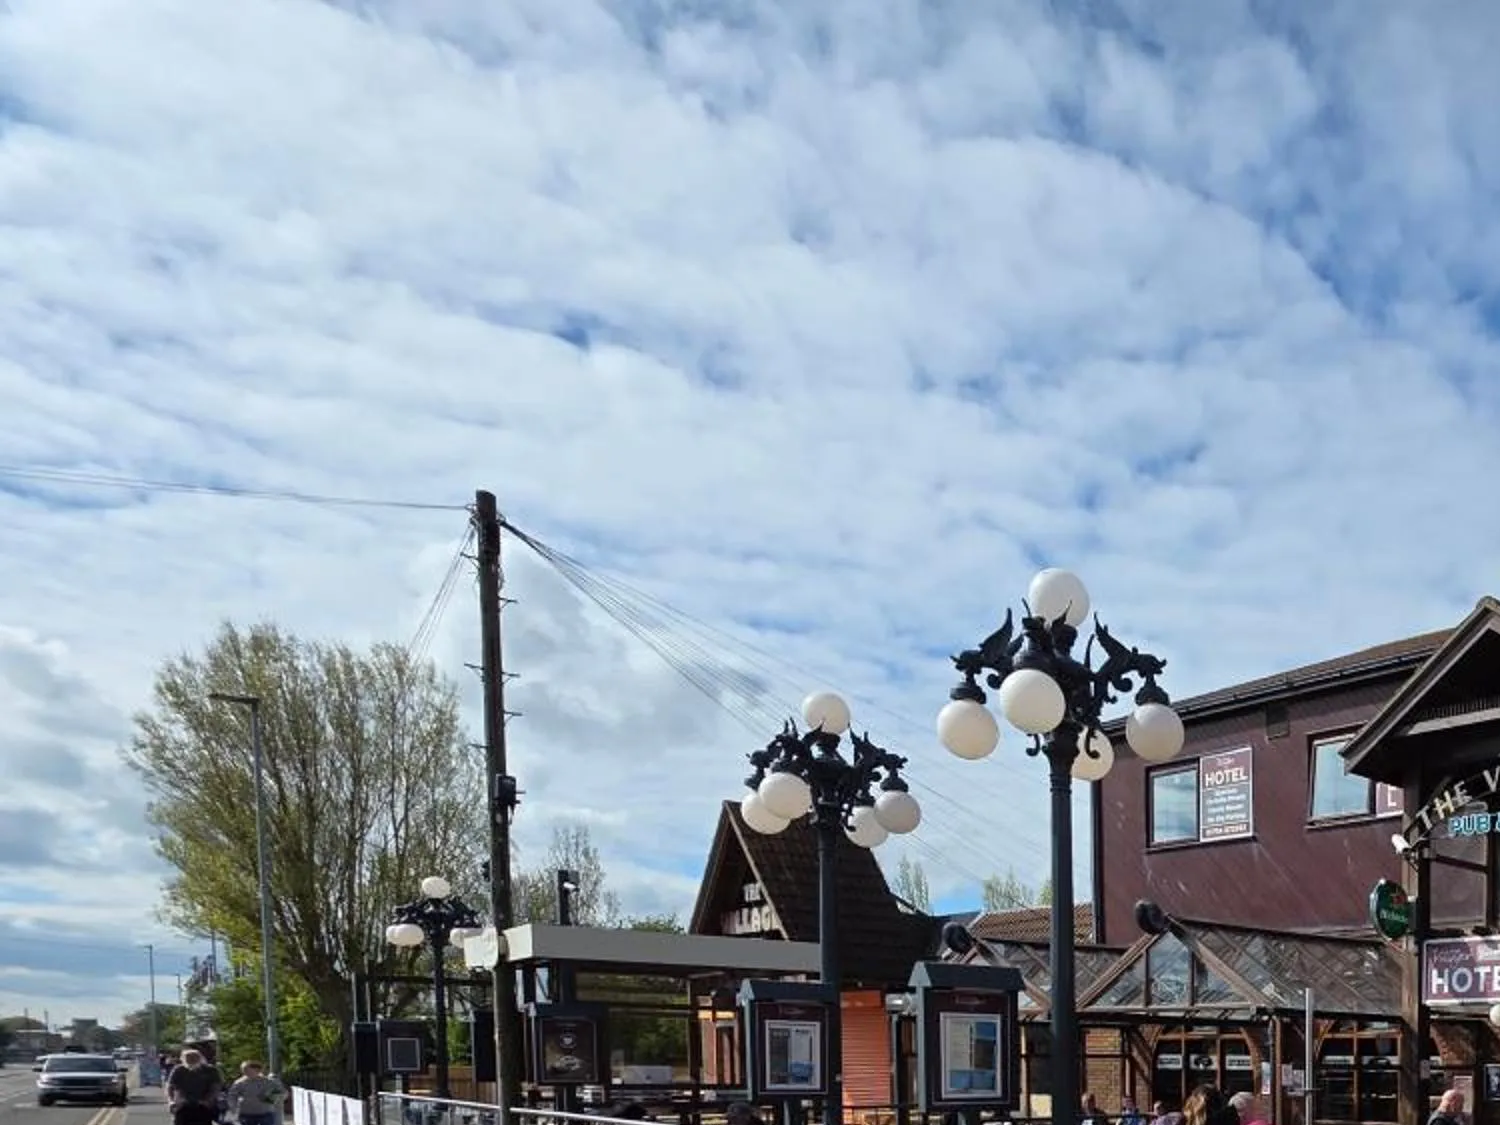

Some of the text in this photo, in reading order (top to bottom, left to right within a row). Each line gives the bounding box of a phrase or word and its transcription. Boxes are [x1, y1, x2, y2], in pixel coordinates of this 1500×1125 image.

[1205, 767, 1249, 788] HOTEL
[1416, 780, 1473, 830] THE
[1448, 814, 1491, 837] PUB
